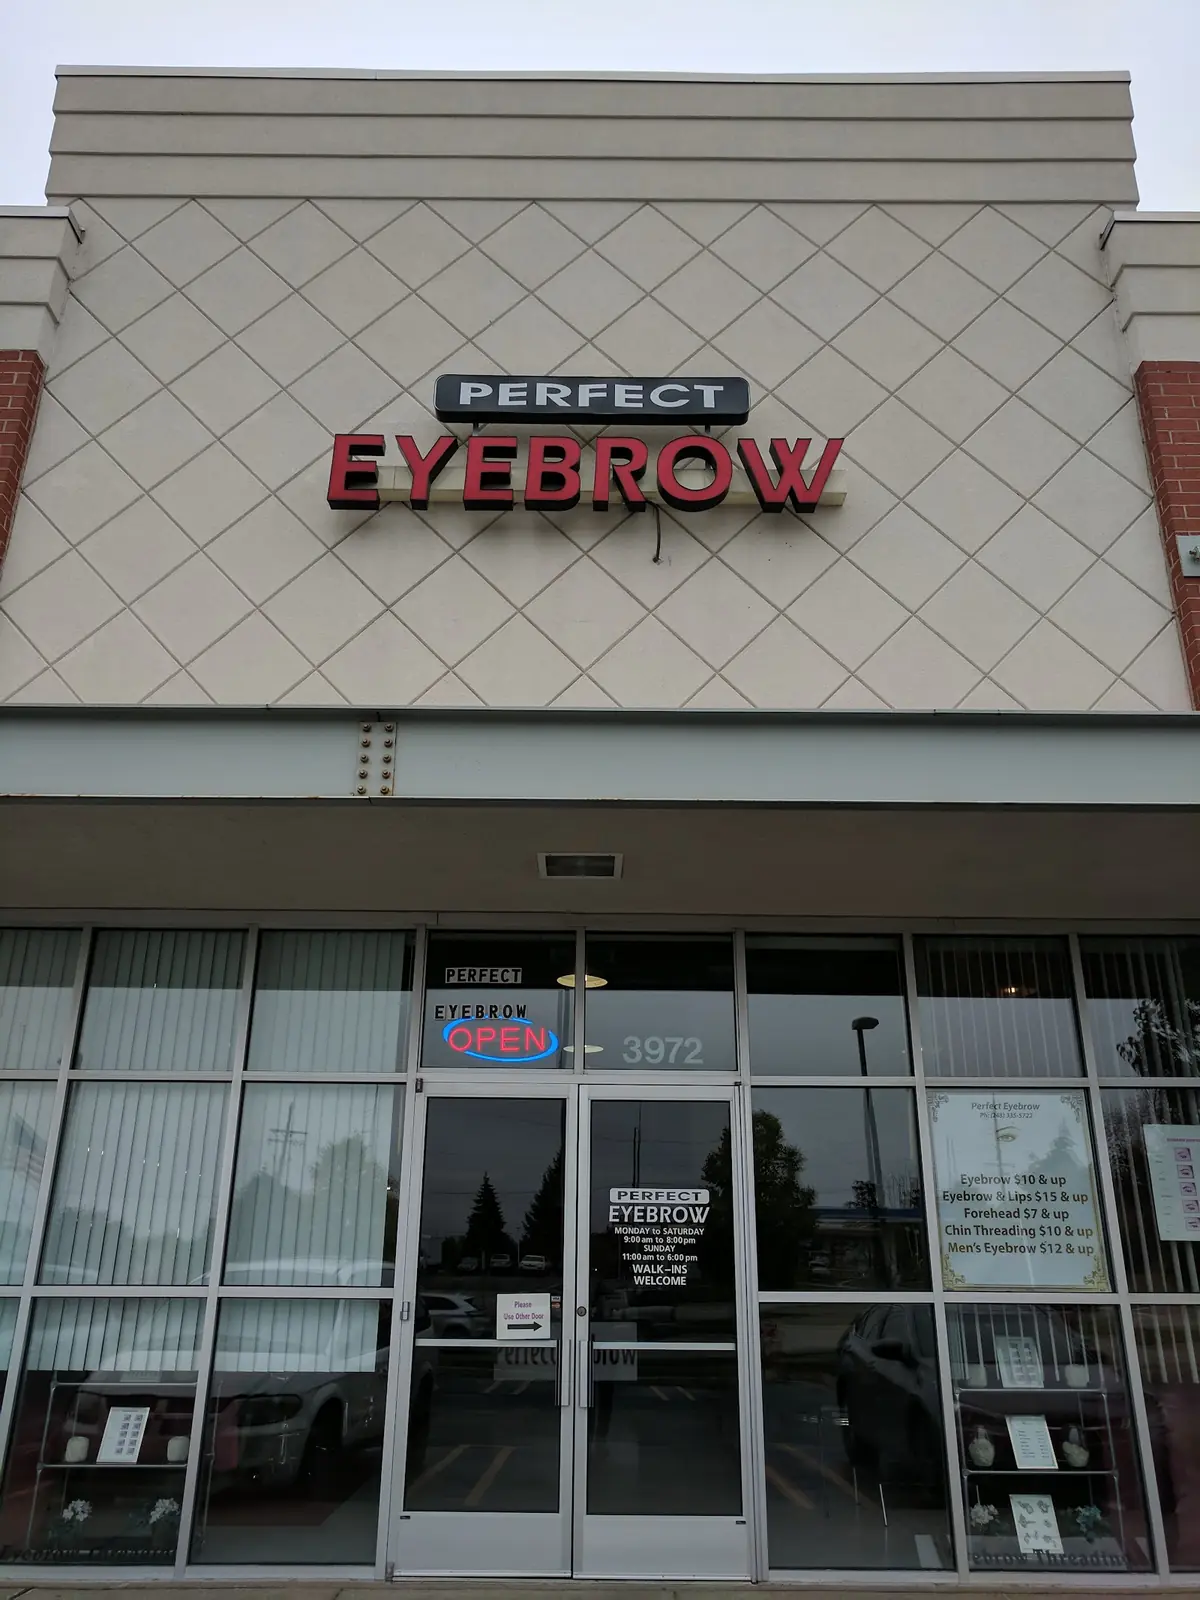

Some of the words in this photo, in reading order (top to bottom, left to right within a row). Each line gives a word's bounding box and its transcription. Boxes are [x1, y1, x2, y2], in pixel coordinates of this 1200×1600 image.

[459, 381, 725, 409] PERFECT
[327, 433, 845, 513] EYEBROW
[446, 968, 522, 983] PERFECT
[434, 1004, 528, 1020] EYEBROW
[448, 1026, 546, 1052] OPEN
[622, 1036, 704, 1065] 3972
[971, 1102, 1001, 1110] Perfect
[1003, 1102, 1040, 1112] Eyebrow
[960, 1174, 1010, 1187] Eyebrow
[1014, 1174, 1036, 1186] $10
[1038, 1175, 1048, 1185] &
[1051, 1176, 1067, 1187] up
[617, 1191, 702, 1202] PERFECT
[943, 1190, 992, 1204] Eyebrow
[996, 1191, 1005, 1201] &
[1008, 1191, 1032, 1204] Lips
[1035, 1191, 1057, 1203] $15
[1060, 1192, 1070, 1202] &
[1073, 1194, 1089, 1205] up
[609, 1205, 710, 1223] EYEBROW
[964, 1208, 1020, 1219] Forehead
[1024, 1208, 1038, 1220] $7
[1041, 1209, 1050, 1219] &
[1053, 1211, 1070, 1222] up
[614, 1227, 650, 1235] MONDAY
[663, 1227, 705, 1235] SATURDAY
[945, 1225, 971, 1236] Chin
[973, 1225, 1036, 1238] Threading
[1039, 1225, 1062, 1237] $10
[1065, 1226, 1074, 1236] &
[1077, 1228, 1093, 1239] up
[948, 1242, 982, 1253] Men's
[984, 1242, 1036, 1256] Eyebrow
[1039, 1242, 1062, 1255] $12
[1065, 1244, 1075, 1254] &
[1078, 1246, 1094, 1256] up
[633, 1275, 687, 1286] WELCOME
